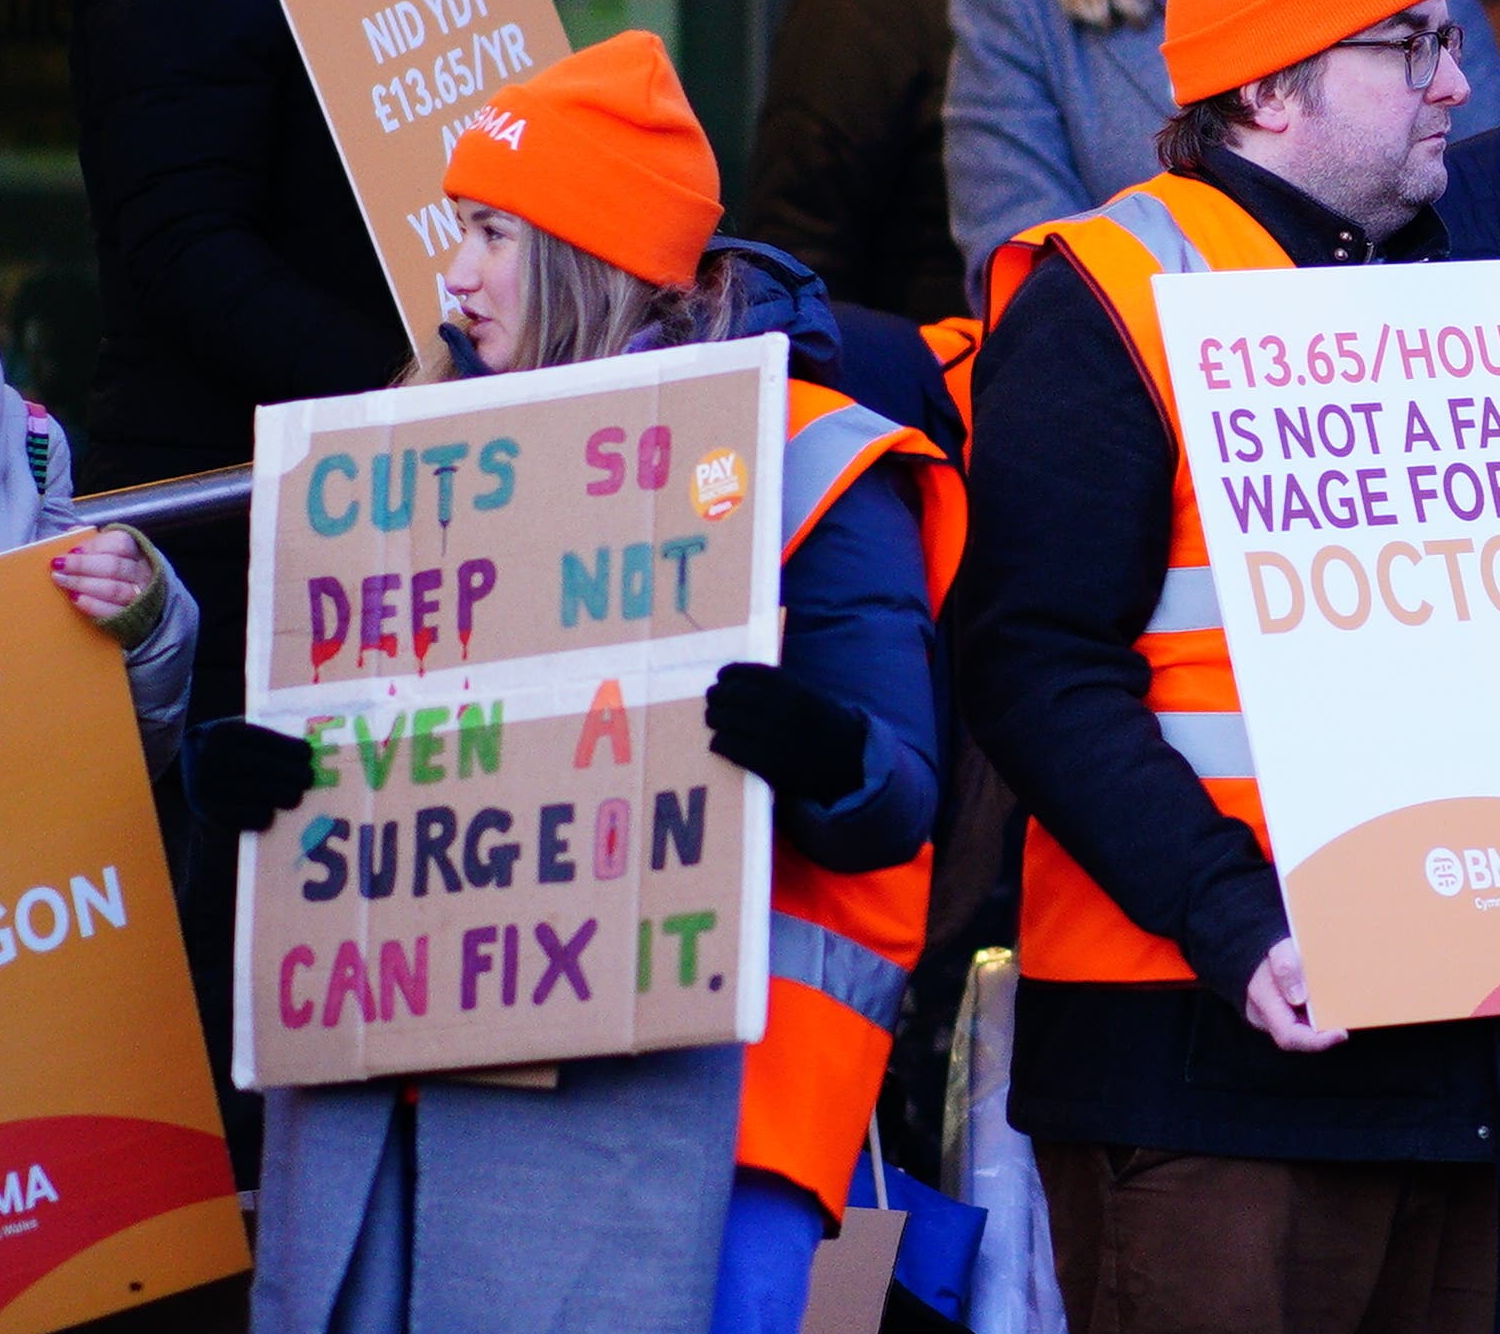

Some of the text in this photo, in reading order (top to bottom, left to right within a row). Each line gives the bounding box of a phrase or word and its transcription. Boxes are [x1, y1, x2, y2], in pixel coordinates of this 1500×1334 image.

[362, 0, 426, 65] NID
[370, 23, 533, 135] £13.65/YR
[306, 438, 522, 543] CUTS
[584, 424, 673, 498] SO
[1211, 407, 1264, 464] IS
[1273, 401, 1385, 460] NOT
[1403, 398, 1441, 453] A
[1221, 467, 1399, 534] WAGE
[307, 534, 709, 672] DEEP NOT
[304, 678, 633, 792] EVEN A
[301, 785, 709, 905] SURGEON
[277, 910, 726, 1031] CAN FIX IT.
